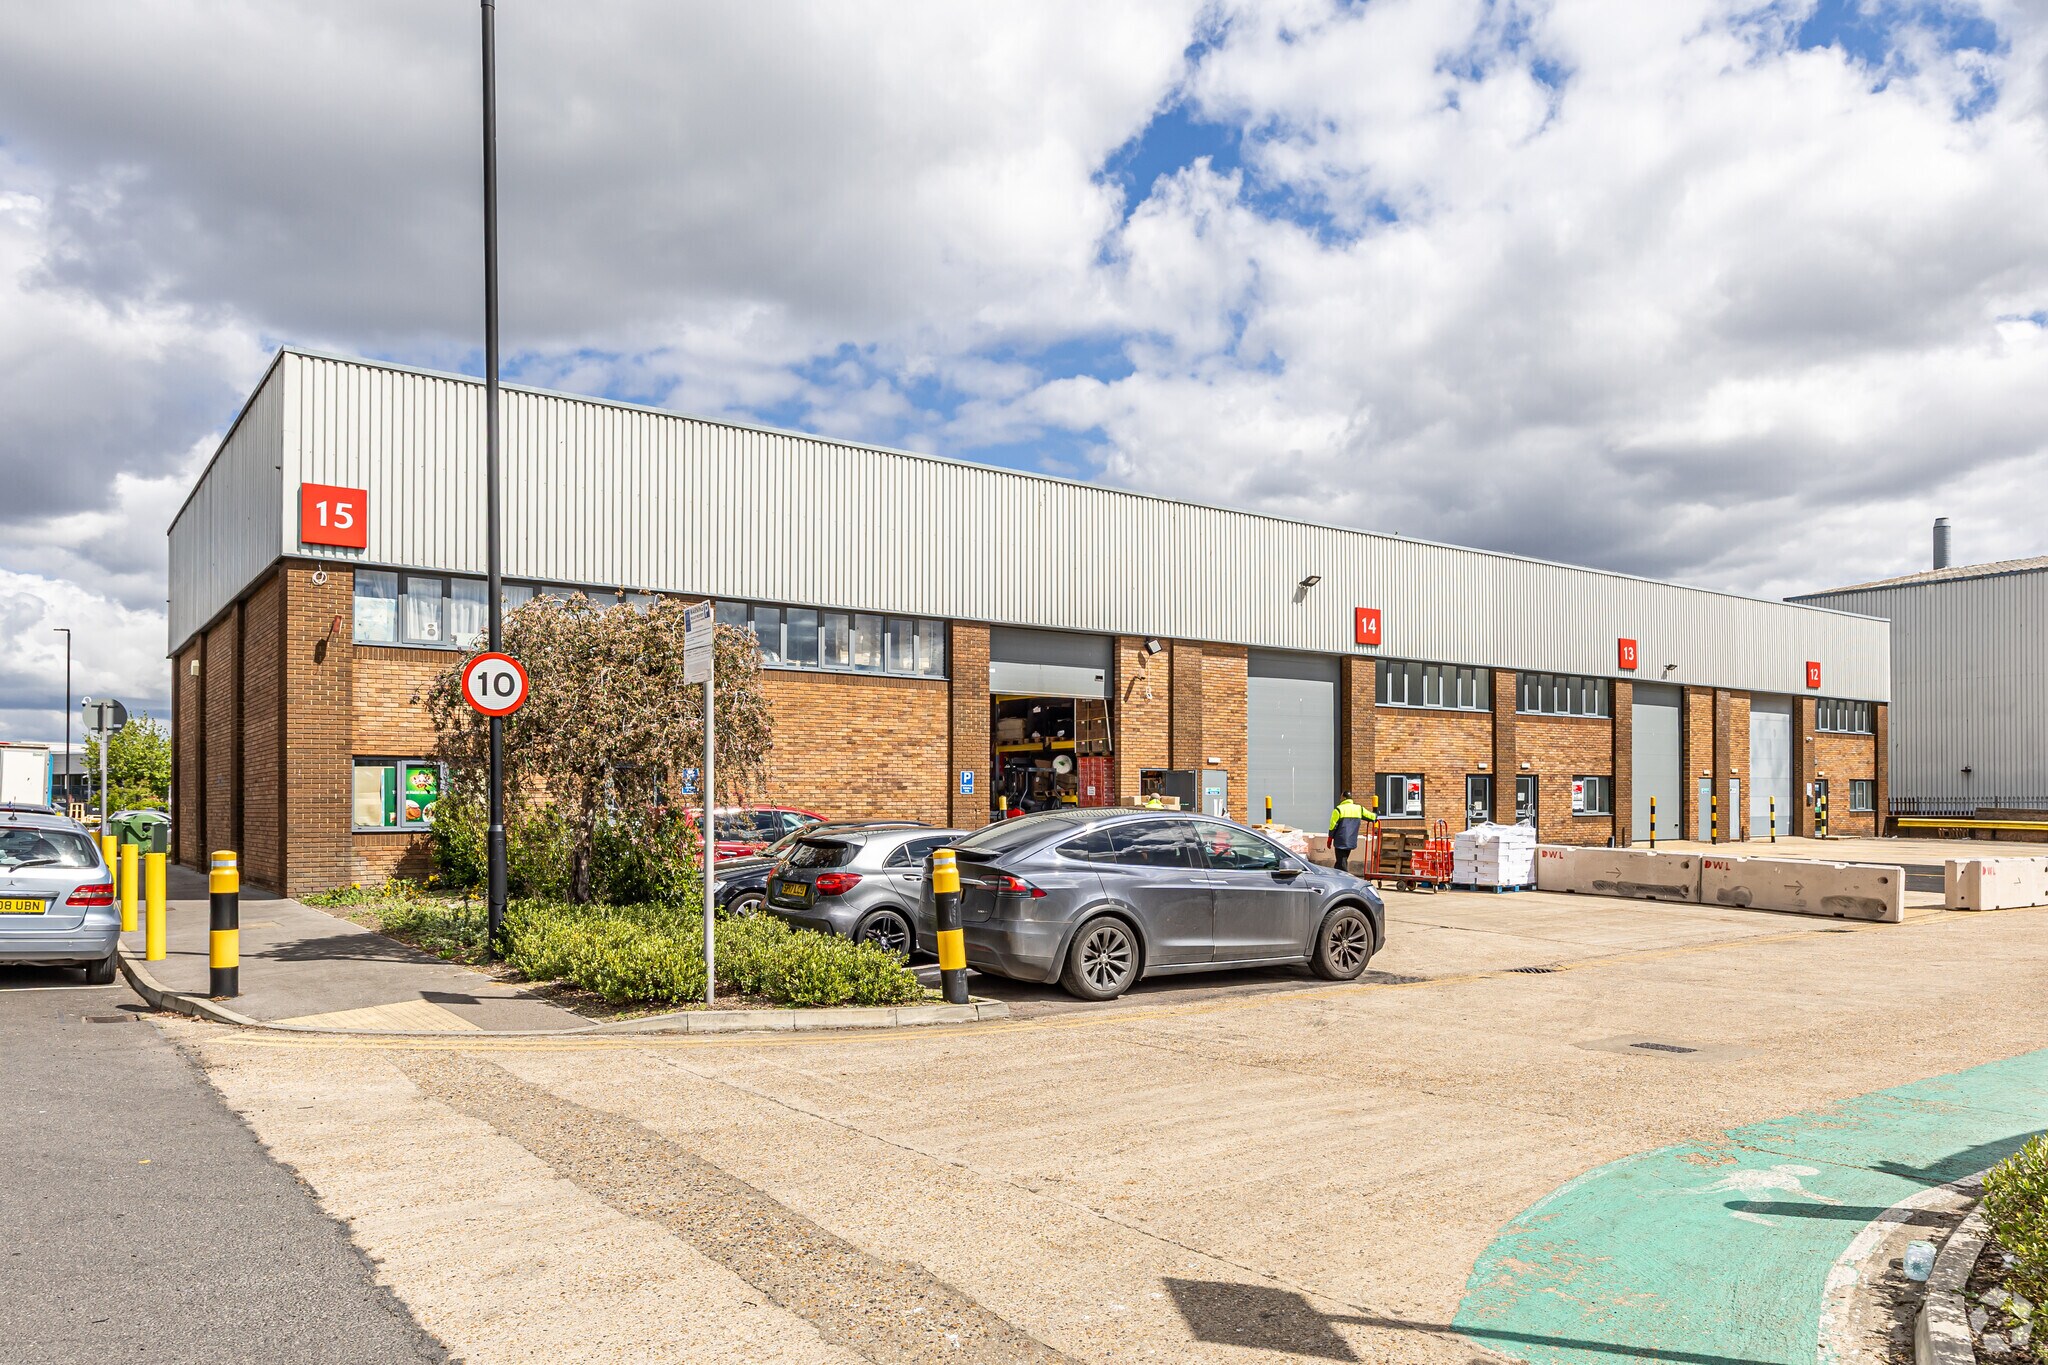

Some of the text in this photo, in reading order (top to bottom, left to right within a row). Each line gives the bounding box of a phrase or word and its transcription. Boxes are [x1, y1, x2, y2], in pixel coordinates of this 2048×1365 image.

[316, 500, 353, 529] 15
[1361, 617, 1377, 634] 14
[1623, 646, 1634, 660] 13
[1810, 668, 1819, 680] 12
[477, 671, 515, 698] 10
[964, 772, 971, 783] P
[1541, 850, 1564, 859] DWL
[1704, 860, 1730, 871] DWL
[1982, 866, 1996, 876] DWL
[16, 901, 40, 910] UBN
